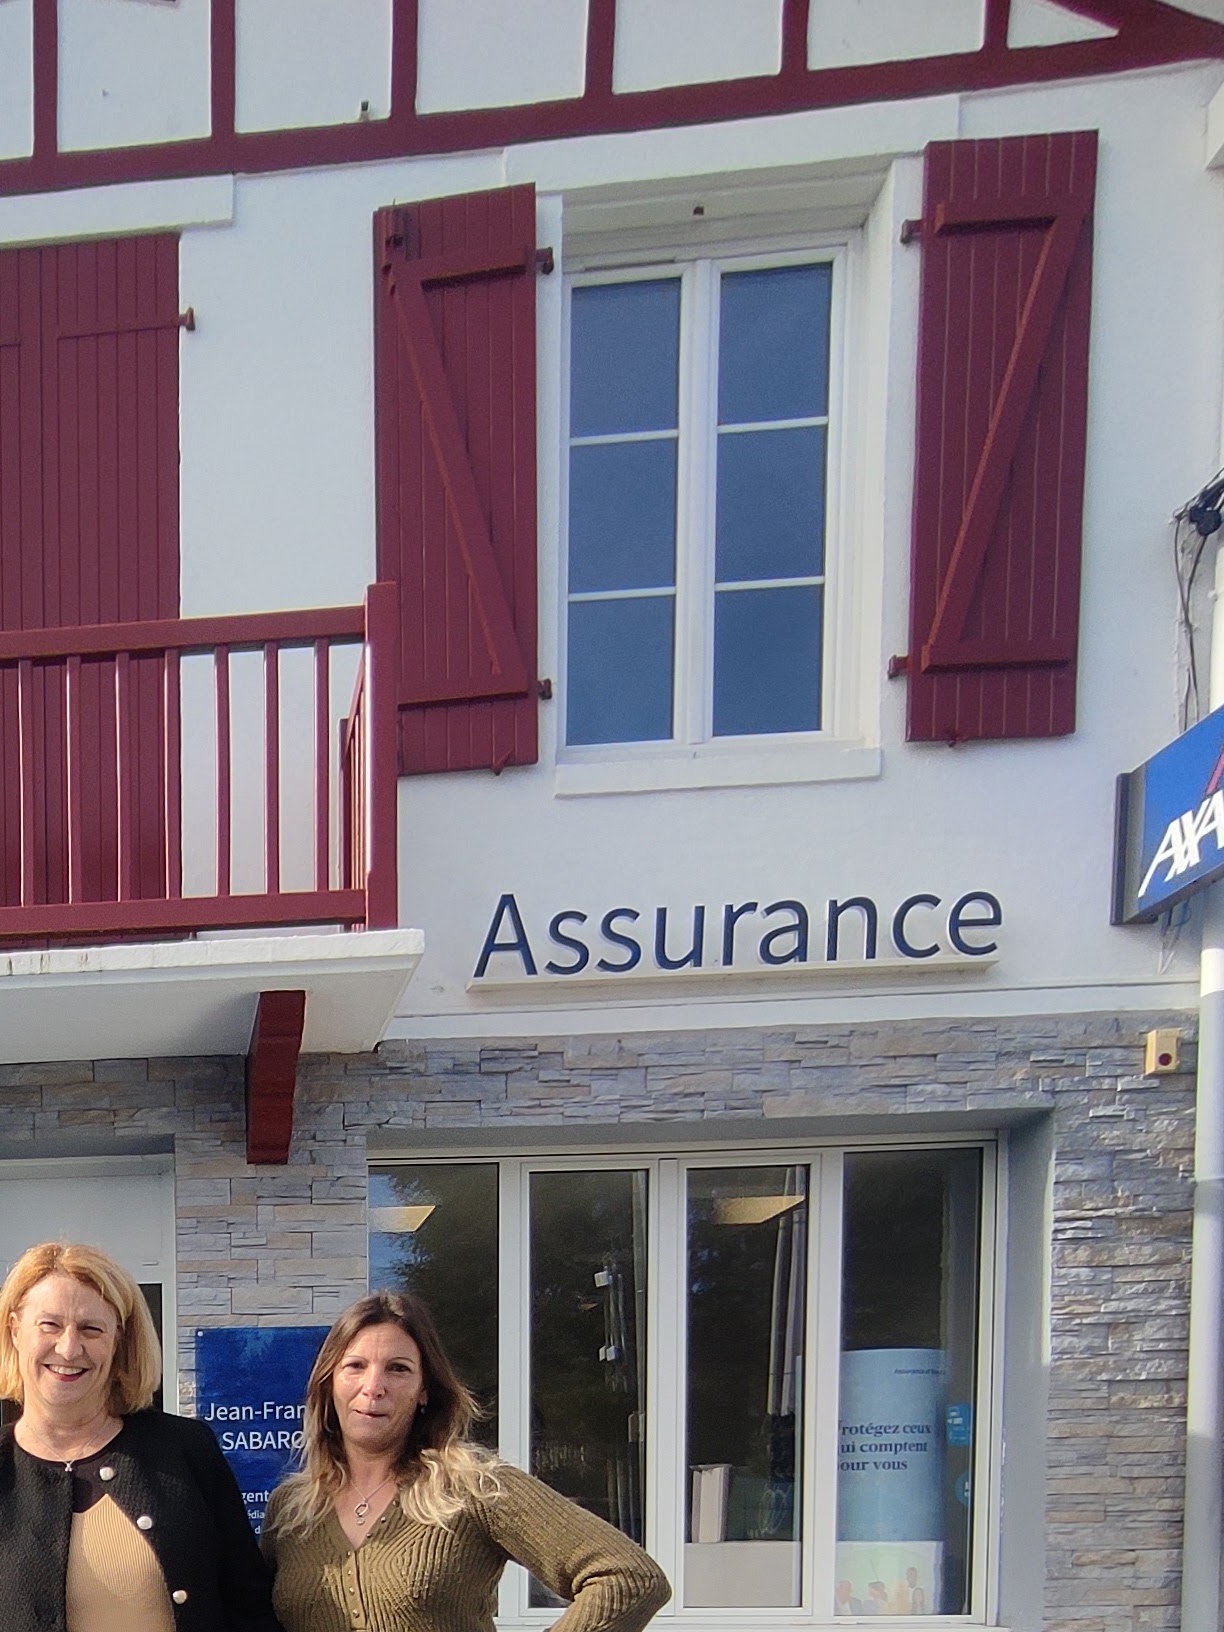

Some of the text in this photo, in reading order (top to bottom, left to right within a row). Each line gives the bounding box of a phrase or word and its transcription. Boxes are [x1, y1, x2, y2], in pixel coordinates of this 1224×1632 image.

[1138, 789, 1224, 898] AXA
[472, 889, 1003, 979] Assurance
[838, 1420, 932, 1438] rotégez ceux
[838, 1441, 928, 1455] ui comptent
[838, 1460, 908, 1472] our vous
